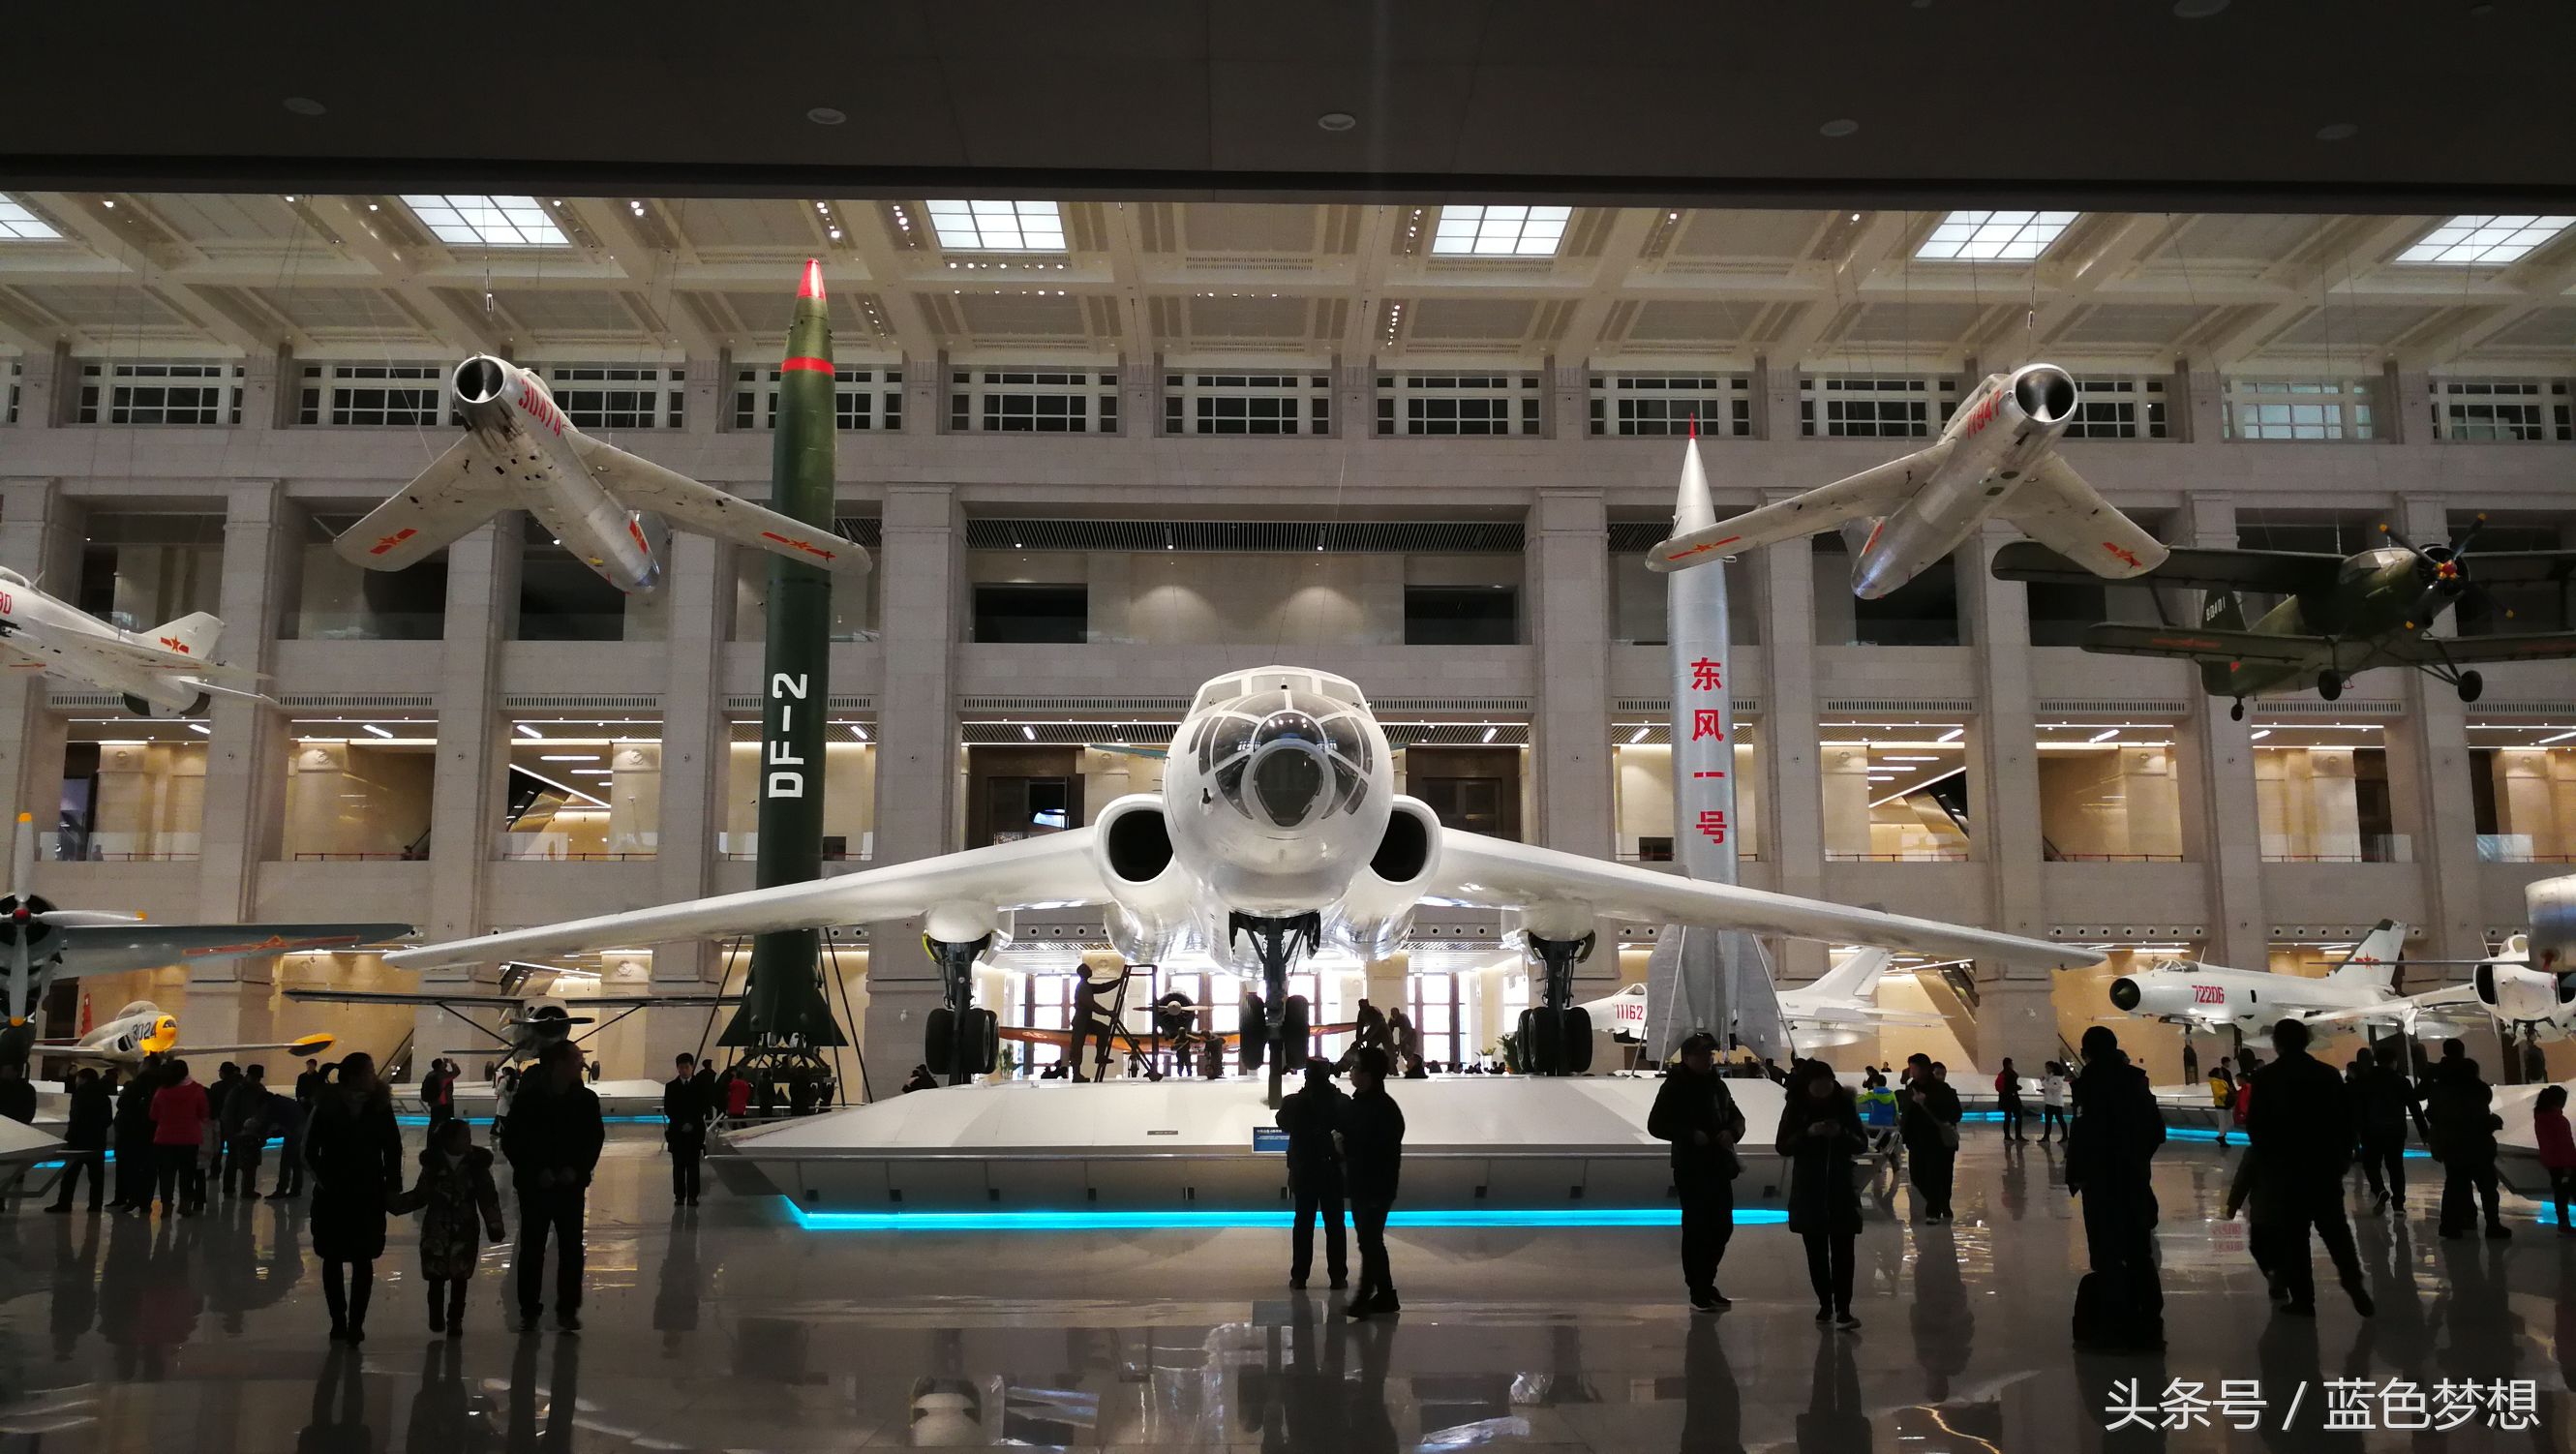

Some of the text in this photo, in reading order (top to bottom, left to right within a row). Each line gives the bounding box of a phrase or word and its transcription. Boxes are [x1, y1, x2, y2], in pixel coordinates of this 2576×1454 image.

[768, 673, 807, 799] DF-2
[1691, 657, 1727, 844] 东风一号
[1616, 1004, 1644, 1020] 11162
[2192, 984, 2225, 1005] 72206
